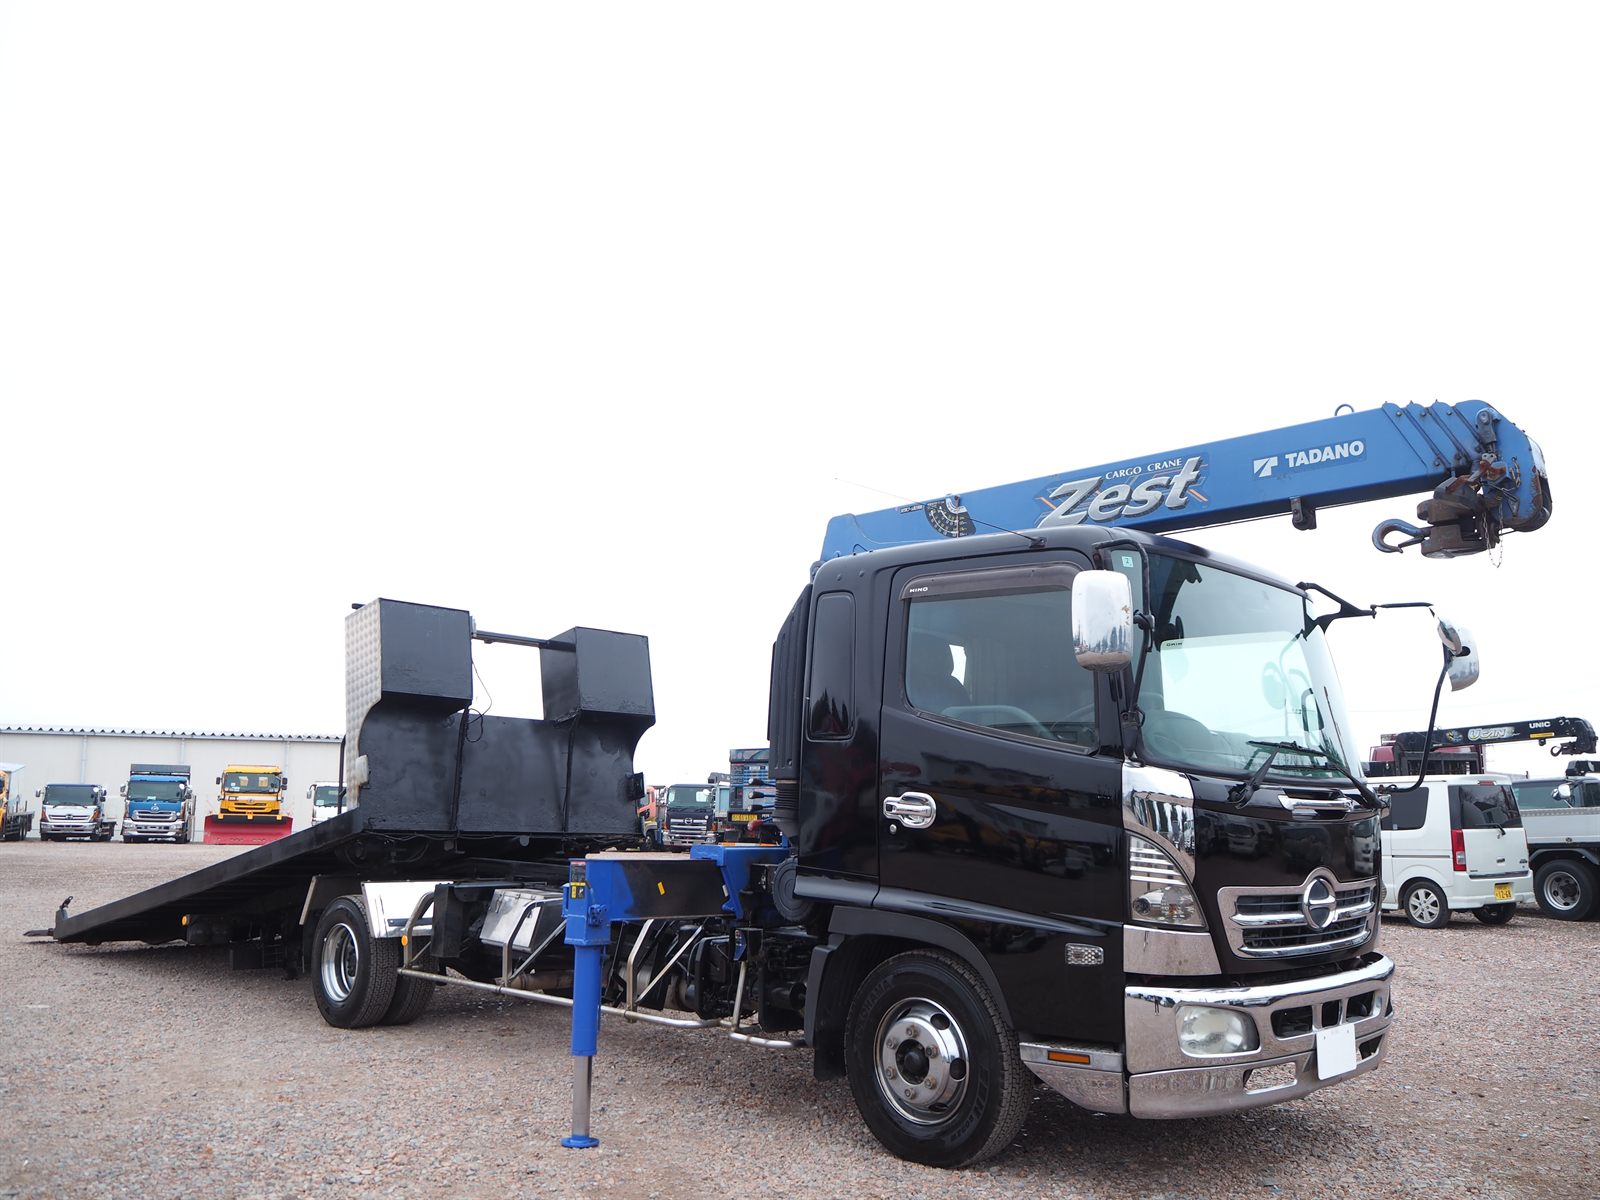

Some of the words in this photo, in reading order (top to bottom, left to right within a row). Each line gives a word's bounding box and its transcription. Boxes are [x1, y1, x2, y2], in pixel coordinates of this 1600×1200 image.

[1285, 440, 1364, 468] TADANO
[1105, 466, 1142, 480] CARGO
[1147, 458, 1182, 472] CRANE
[1037, 456, 1201, 528] Zest
[1529, 721, 1551, 729] UNIC
